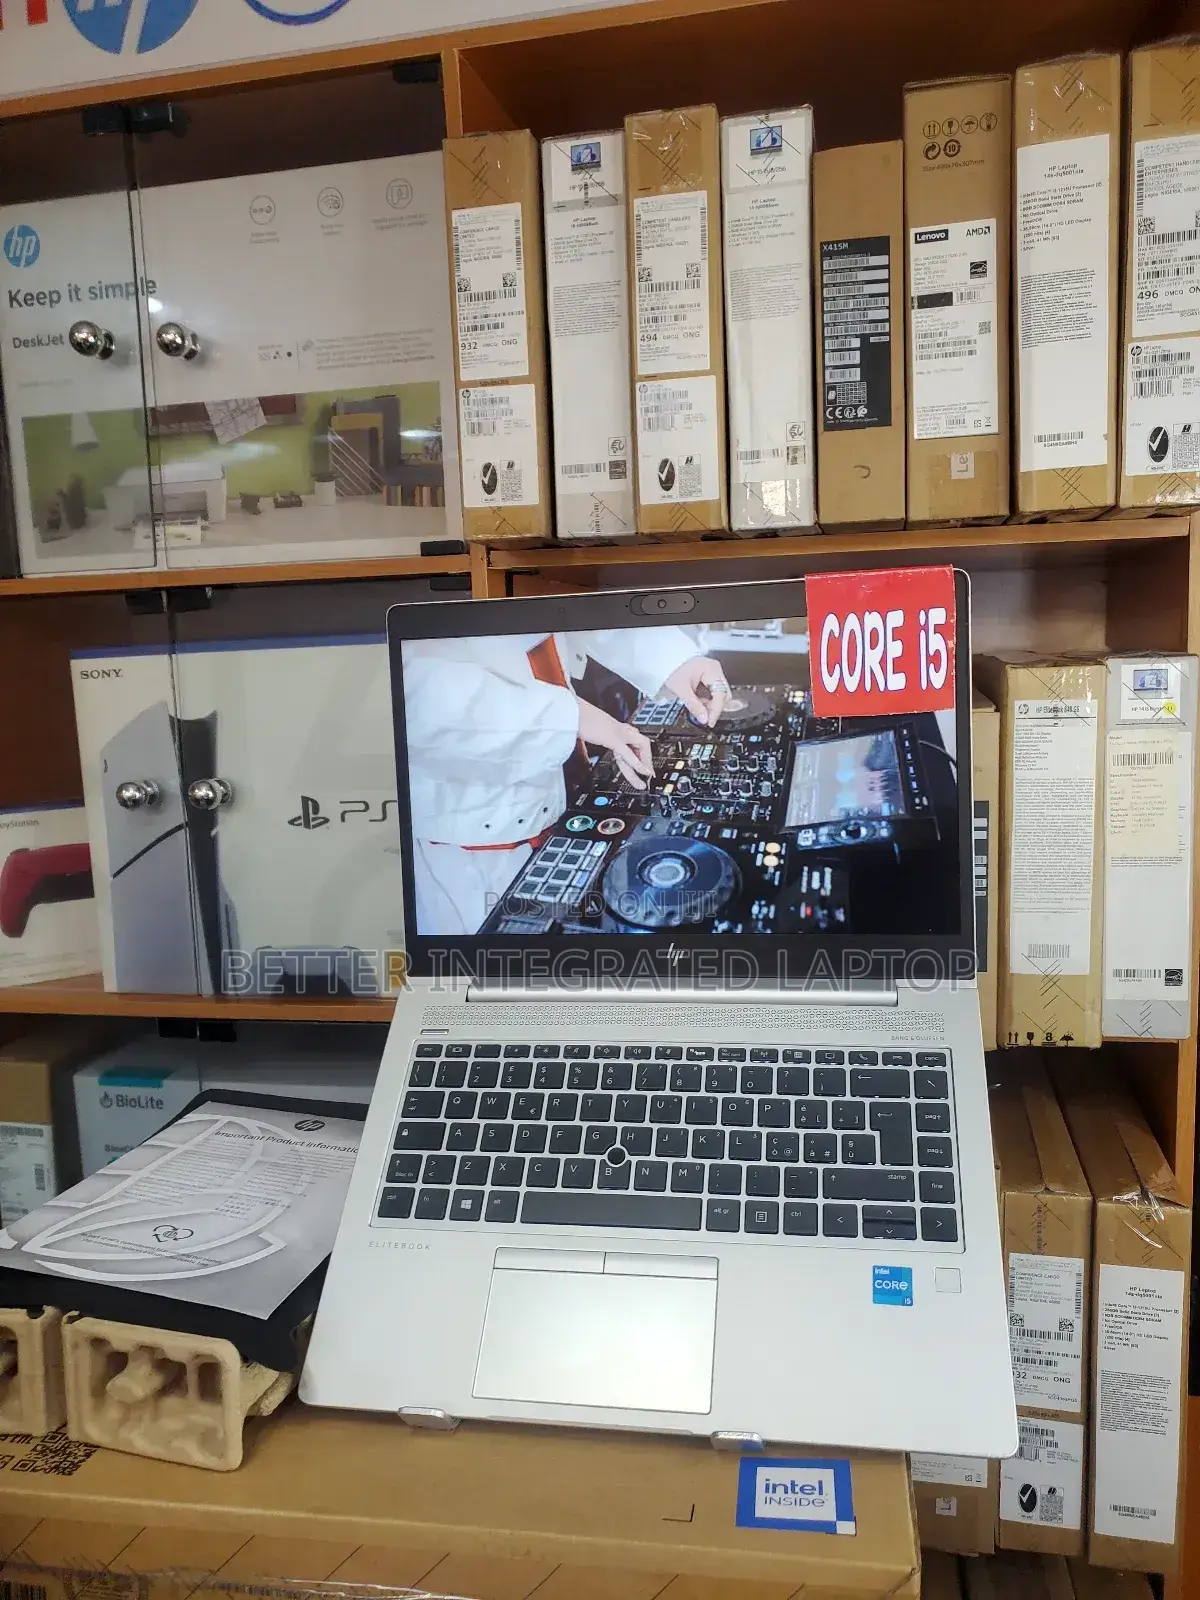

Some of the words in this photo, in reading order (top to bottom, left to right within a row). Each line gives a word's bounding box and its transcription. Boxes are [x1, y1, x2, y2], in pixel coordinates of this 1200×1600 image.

[916, 231, 946, 241] Lenovo
[966, 228, 983, 237] AMD
[4, 224, 40, 268] hp
[823, 243, 848, 251] X415M
[8, 288, 62, 309] Keep
[68, 282, 81, 302] it
[88, 276, 157, 301] simple
[1138, 290, 1158, 299] 496
[12, 333, 65, 349] DeskJet
[640, 334, 657, 342] 494
[461, 342, 478, 350] 932
[820, 609, 907, 693] CORE
[918, 607, 948, 690] i5
[80, 669, 123, 679] SONY
[115, 1094, 164, 1110] BioLite
[452, 1097, 461, 1105] Q
[587, 1099, 593, 1107] T
[622, 1100, 630, 1108] Y
[657, 1101, 664, 1109] U
[692, 1102, 696, 1110] I
[728, 1103, 737, 1111] O
[764, 1104, 772, 1112] P
[454, 1129, 462, 1137] A
[522, 1130, 530, 1138] D
[592, 1131, 600, 1139] G
[627, 1132, 634, 1140] H
[214, 1131, 265, 1141] Important
[266, 1136, 305, 1147] Product
[662, 1134, 668, 1142] J
[464, 1162, 471, 1170] Z
[499, 1163, 506, 1171] X
[534, 1164, 541, 1172] C
[605, 1168, 612, 1176] B
[642, 1168, 649, 1176] N
[679, 1169, 688, 1177] M
[369, 1241, 430, 1250] ELITEBOOK
[765, 1479, 824, 1495] intel
